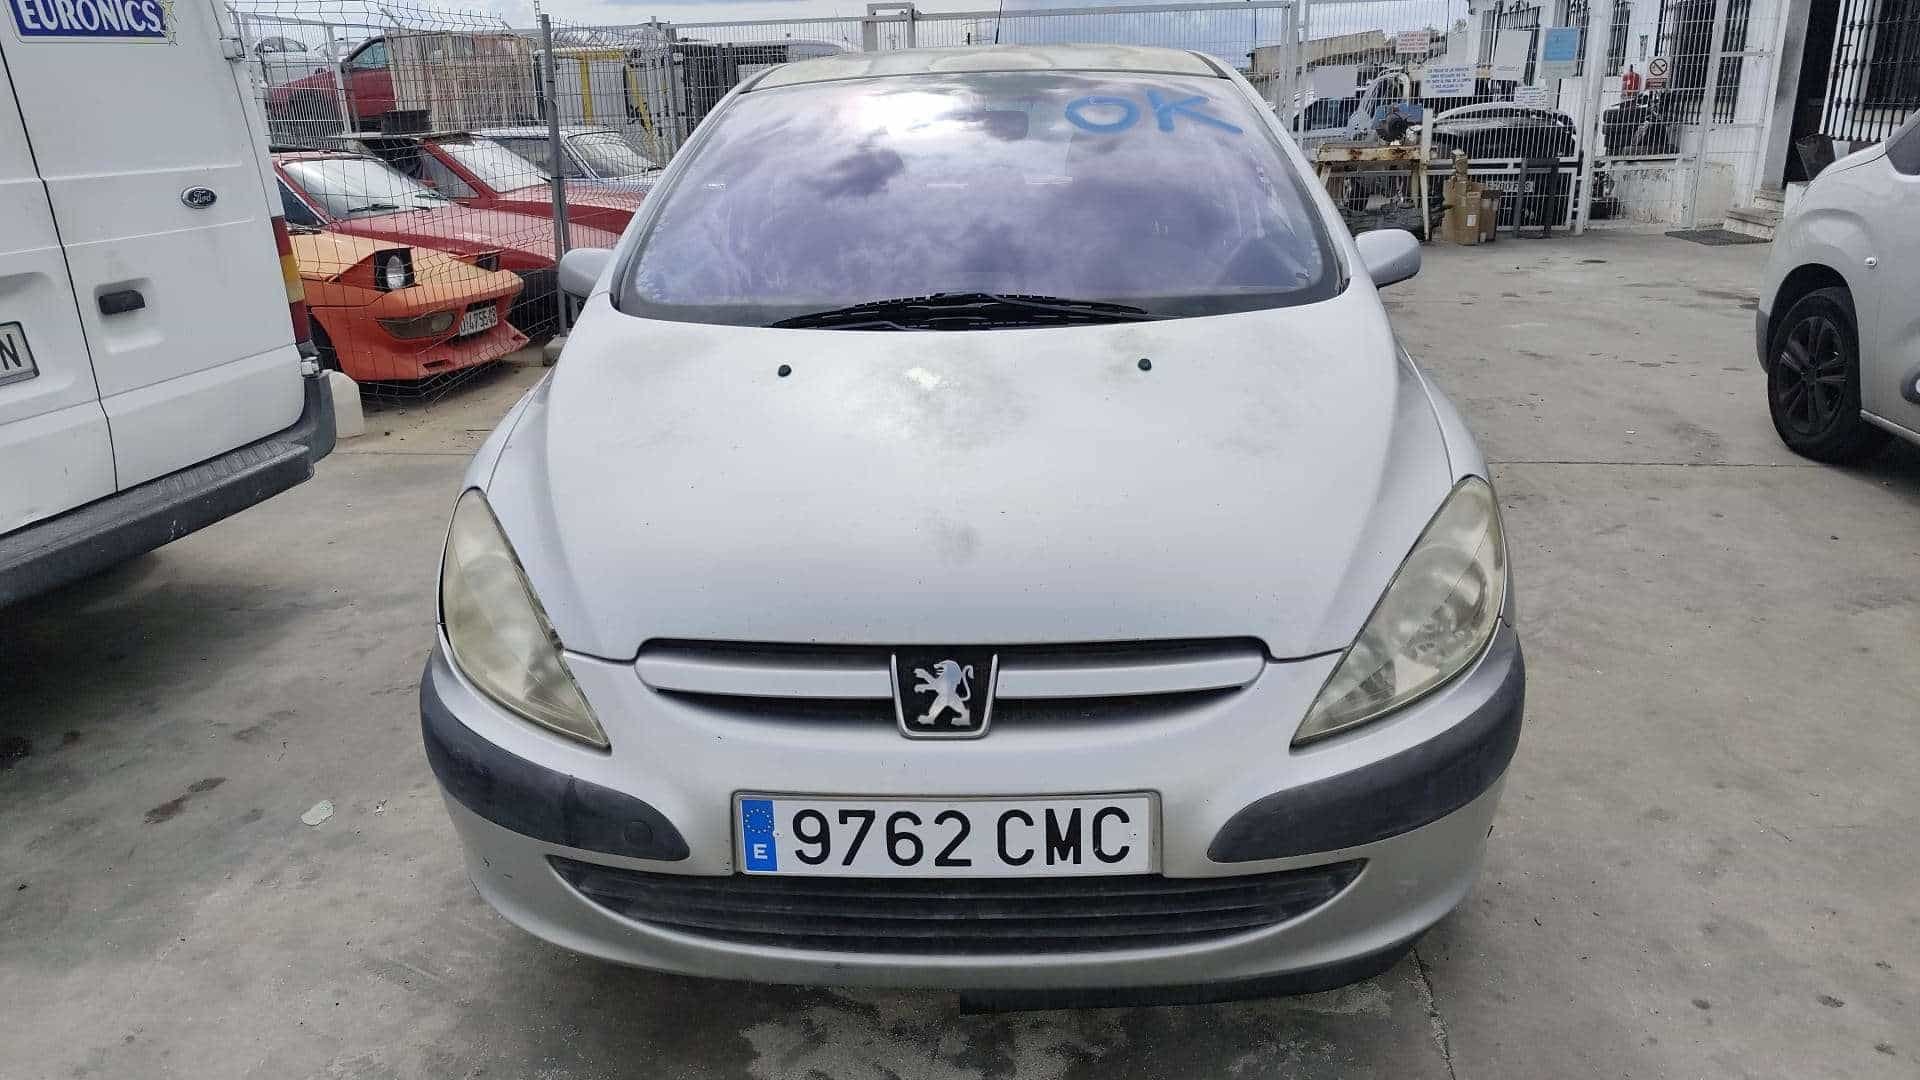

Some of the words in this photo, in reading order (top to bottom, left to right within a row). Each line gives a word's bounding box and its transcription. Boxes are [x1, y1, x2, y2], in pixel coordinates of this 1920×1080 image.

[17, 0, 164, 33] EURONICS
[1064, 88, 1244, 134] OK
[752, 843, 768, 860] E
[792, 808, 972, 867] 9762
[996, 805, 1131, 867] CMC
